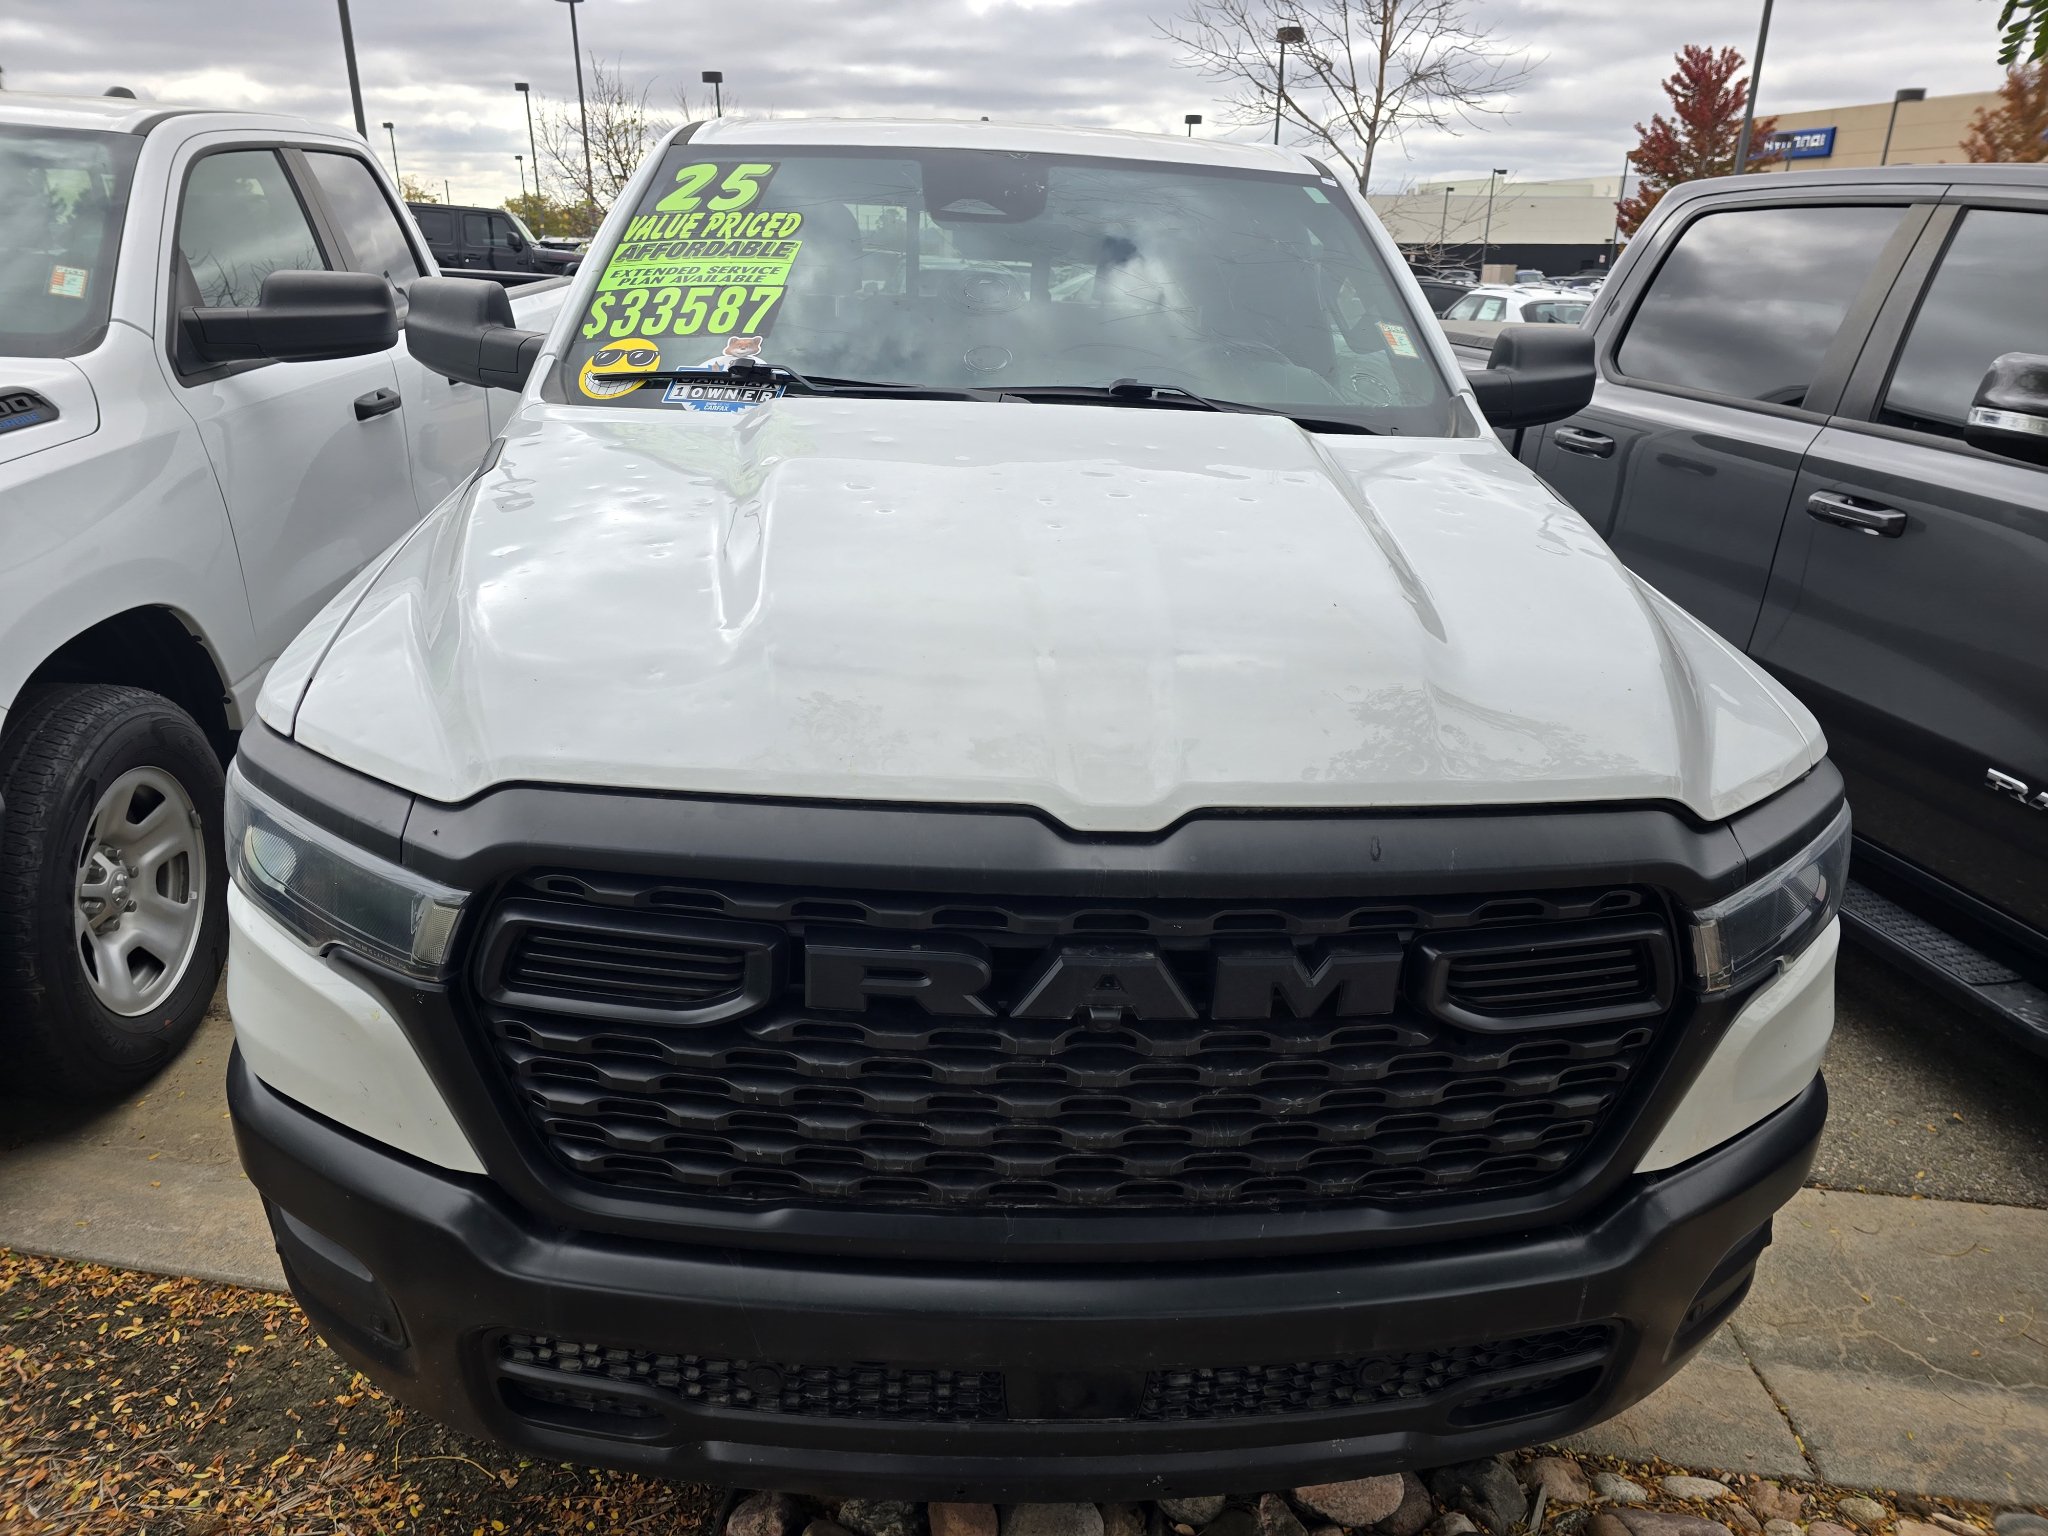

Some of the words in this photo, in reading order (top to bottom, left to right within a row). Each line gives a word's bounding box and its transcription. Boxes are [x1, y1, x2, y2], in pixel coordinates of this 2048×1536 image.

[656, 163, 773, 213] 25
[623, 213, 706, 242] VALUE
[699, 212, 803, 240] PRICED
[615, 240, 799, 262] AFFORDABLE
[610, 266, 700, 279] EXTENDED
[706, 265, 783, 275] SERVICE
[617, 276, 664, 287] PLAN
[668, 274, 767, 284] AVAILABLE
[582, 286, 784, 339] $33587
[691, 387, 774, 402] OWNER
[805, 944, 1404, 1020] RAM
